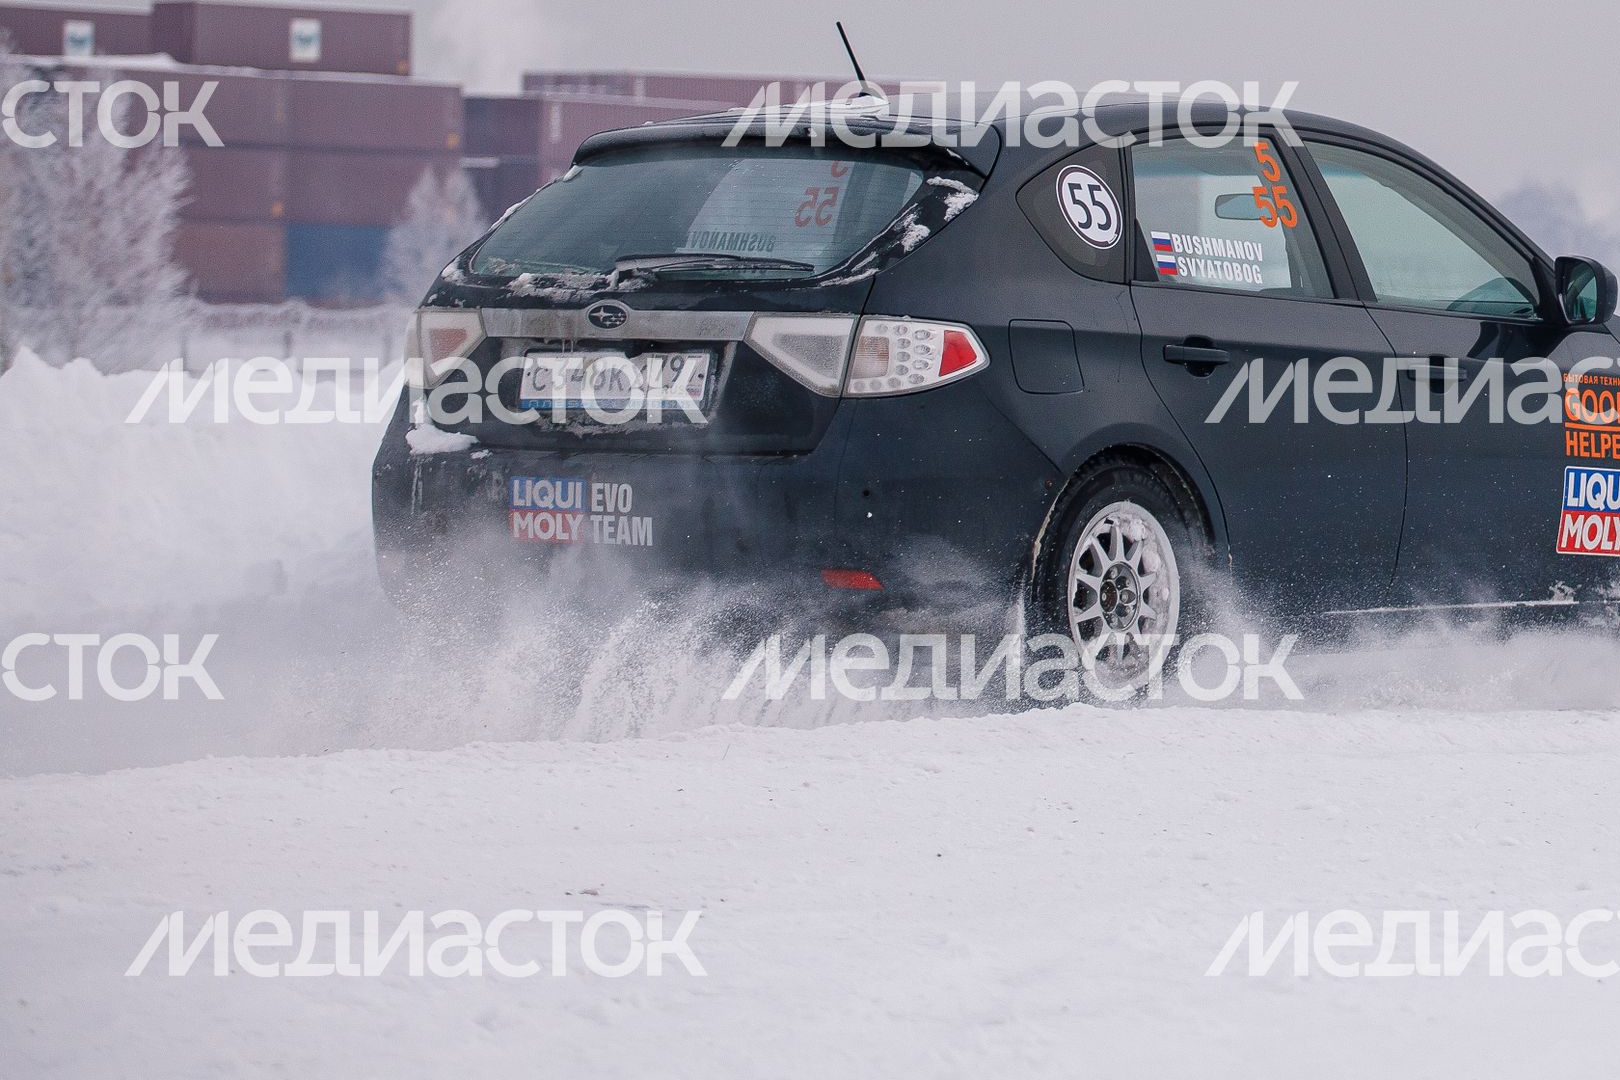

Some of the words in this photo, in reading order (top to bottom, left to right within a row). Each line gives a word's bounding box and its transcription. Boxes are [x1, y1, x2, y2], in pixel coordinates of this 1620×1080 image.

[1252, 141, 1281, 182] 5
[1066, 182, 1113, 231] 55
[1252, 185, 1298, 228] 55
[1171, 233, 1264, 262] BUSHMANOV
[1178, 256, 1263, 285] SVYATOBOG
[513, 479, 583, 509] LIQUI
[591, 482, 633, 513] EVO
[513, 511, 585, 541] MOLY
[590, 514, 653, 547] TEAM
